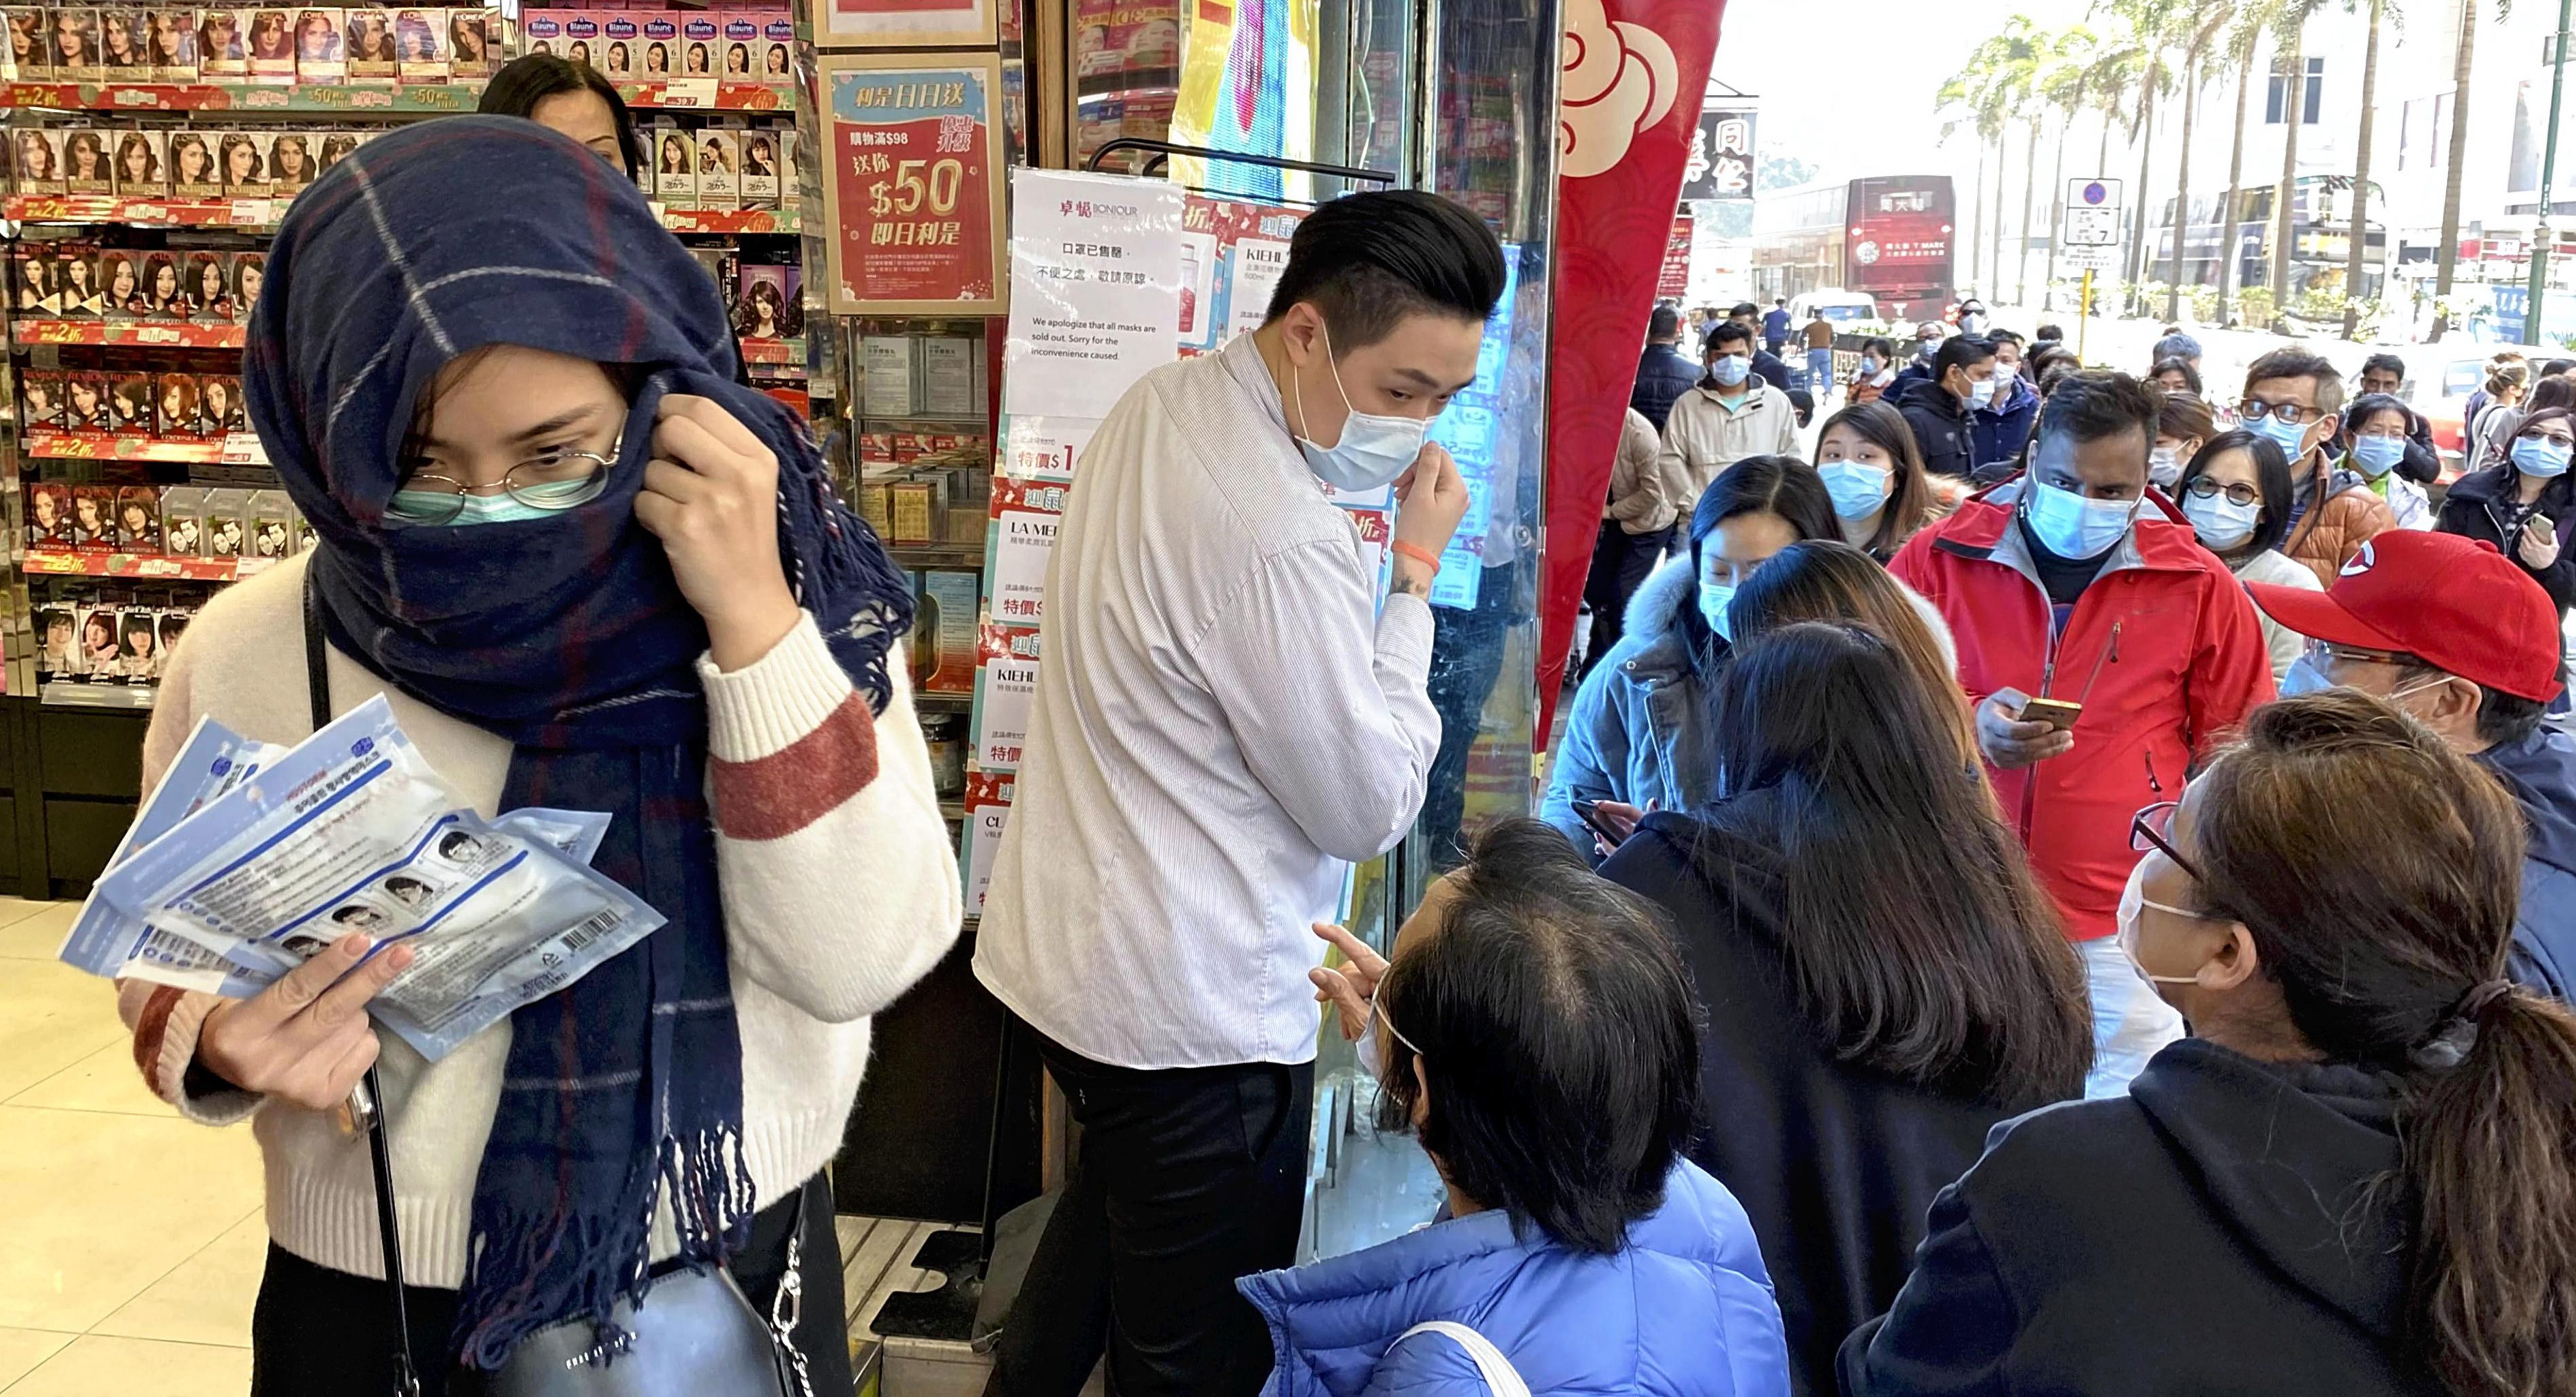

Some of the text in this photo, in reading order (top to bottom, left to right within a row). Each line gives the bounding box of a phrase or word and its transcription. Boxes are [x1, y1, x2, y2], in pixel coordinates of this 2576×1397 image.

[856, 82, 965, 109] 利是日日送
[850, 131, 909, 146] 購物滿$98
[853, 153, 891, 177] 送你
[868, 158, 963, 218] $50
[1093, 204, 1138, 216] BONJOUR
[871, 221, 961, 246] 即日利是
[2099, 230, 2109, 242] 7
[1032, 317, 1046, 326] We
[1047, 318, 1087, 330] apologize
[1089, 322, 1105, 330] that
[1117, 324, 1142, 332] masks
[1032, 332, 1049, 341] sold
[1069, 335, 1090, 346] Sorry
[1092, 336, 1103, 344] for
[1105, 337, 1118, 345] the
[1031, 348, 1089, 359] inconvenience
[1024, 486, 1071, 511] 迎鼠
[1011, 521, 1029, 535] LA
[997, 669, 1037, 683] KIEHL
[990, 745, 1023, 763] 特價
[986, 816, 1005, 828] CL
